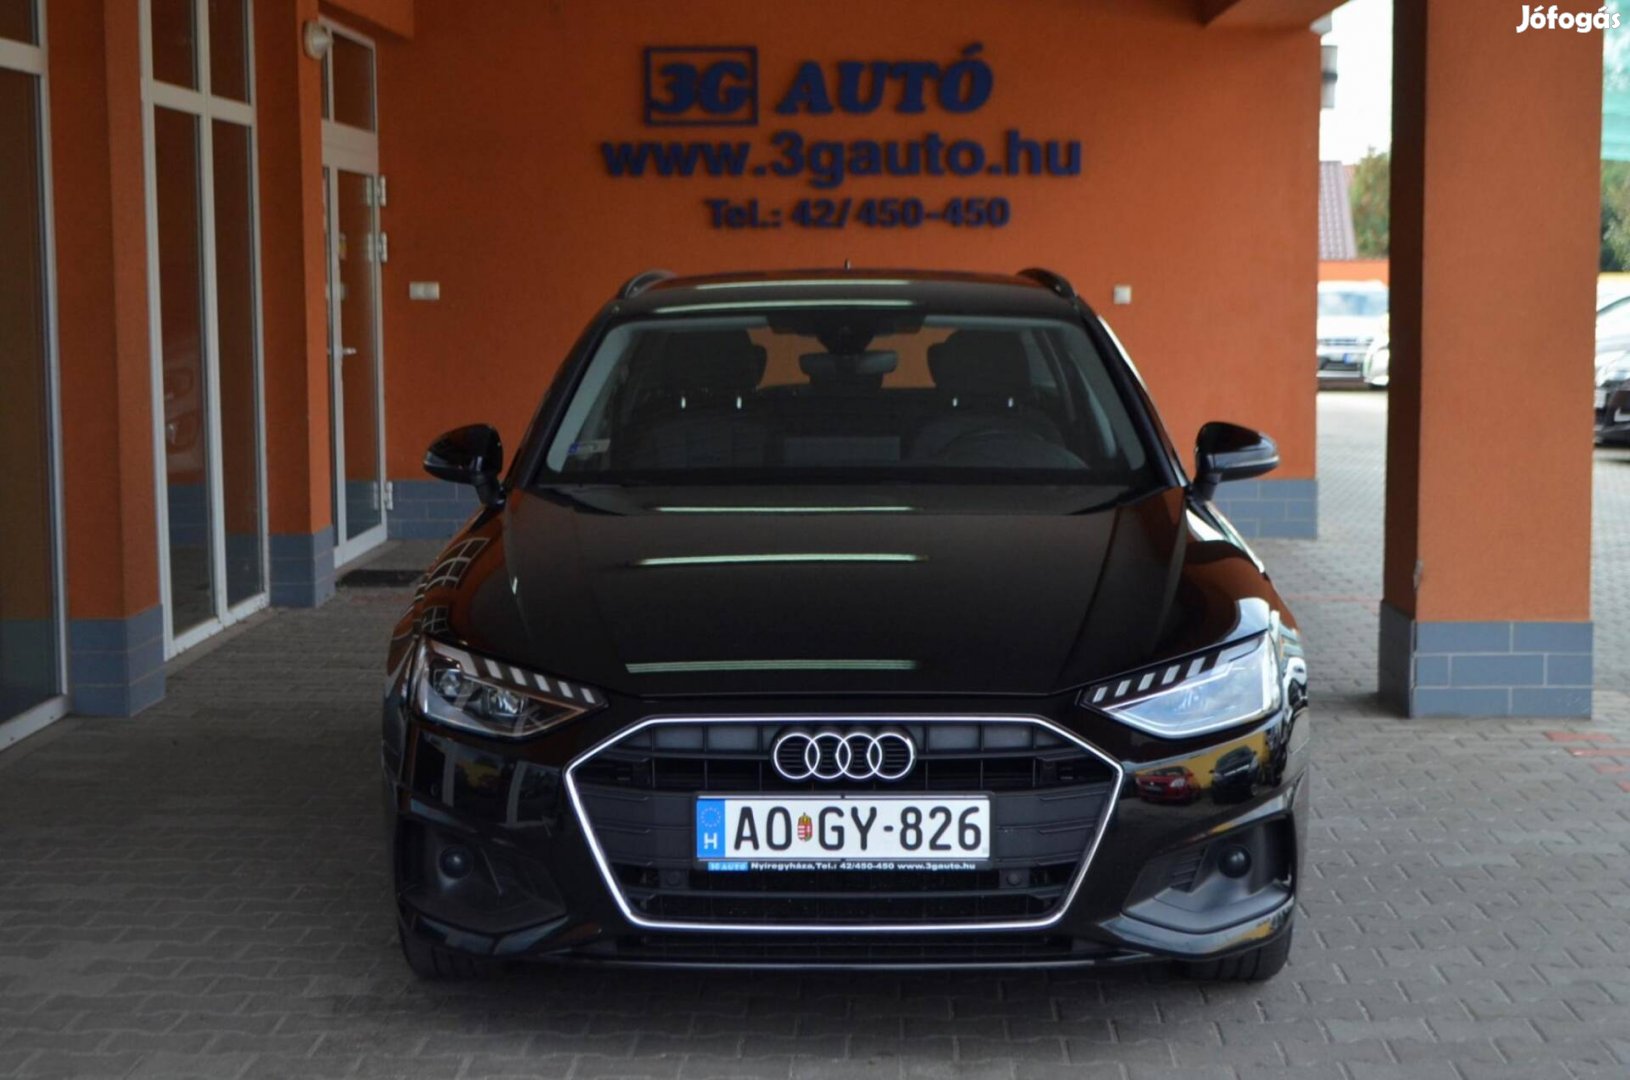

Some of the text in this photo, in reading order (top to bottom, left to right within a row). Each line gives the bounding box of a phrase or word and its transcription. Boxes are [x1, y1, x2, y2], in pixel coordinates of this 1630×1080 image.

[648, 42, 995, 116] 3G AUTÓ
[601, 129, 1082, 189] www.3gauto.hu
[705, 198, 783, 229] Tel.:
[703, 806, 982, 851] H AO GY-826
[897, 862, 976, 871] www.3gauto.hu
